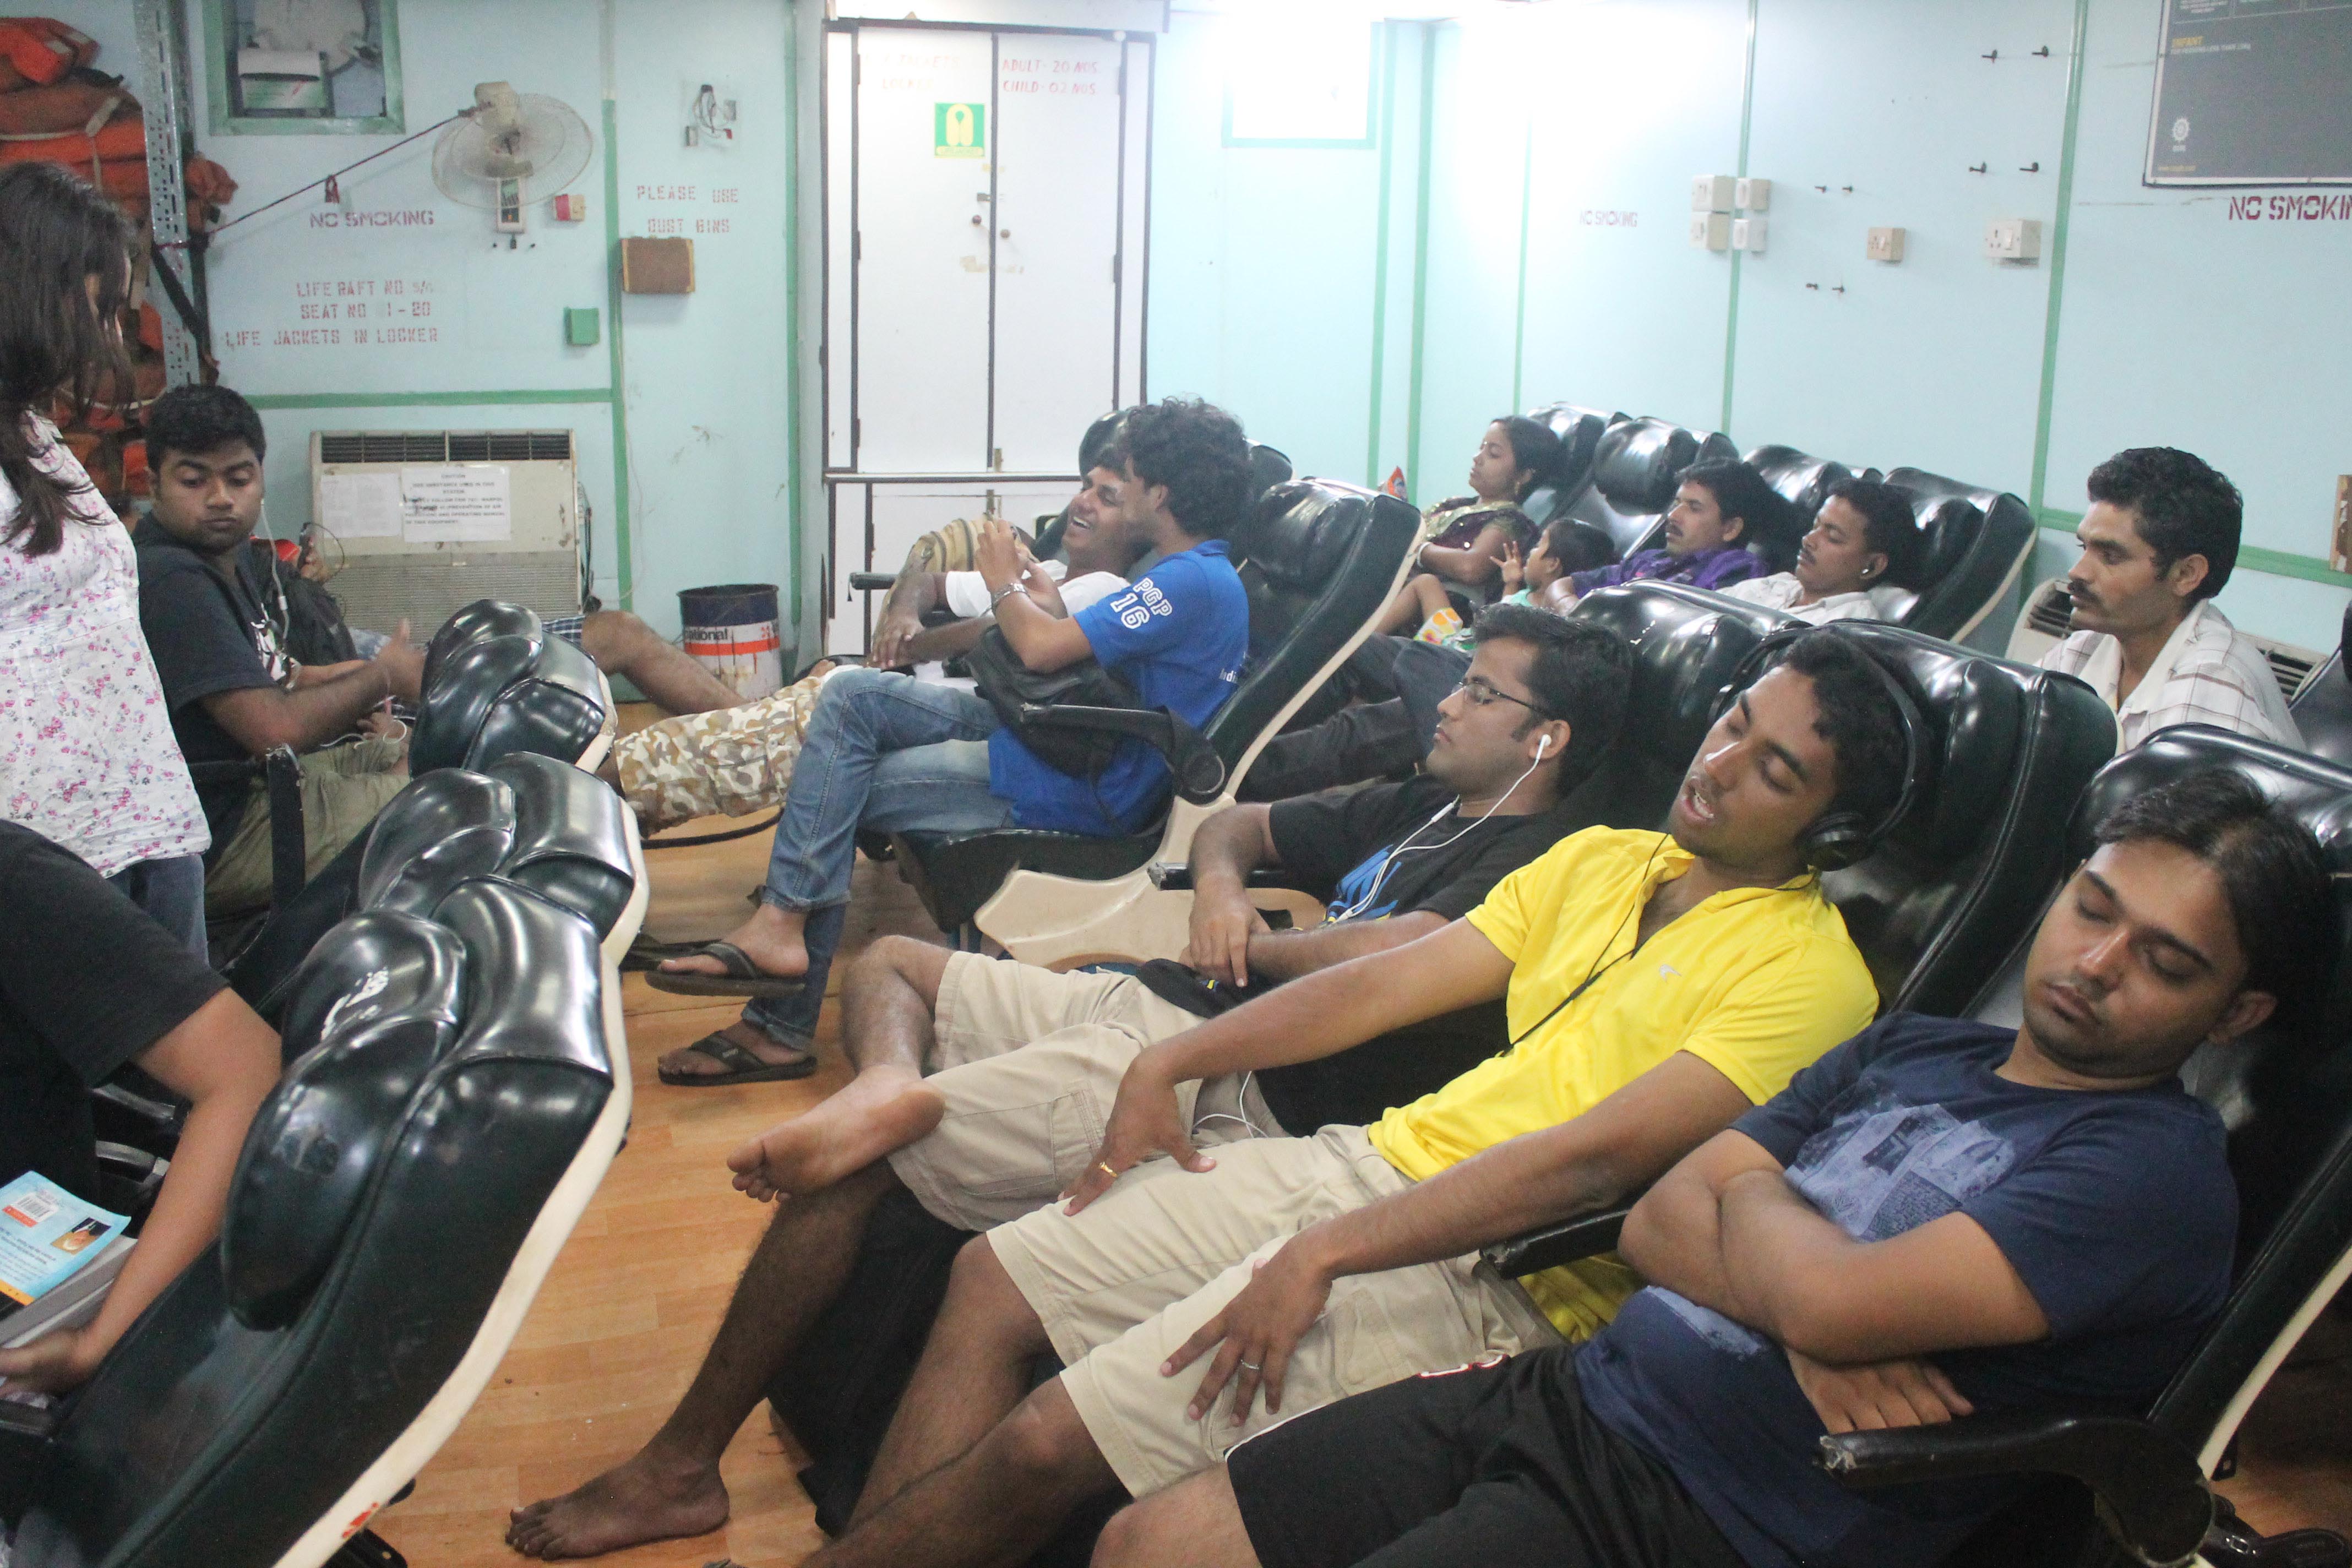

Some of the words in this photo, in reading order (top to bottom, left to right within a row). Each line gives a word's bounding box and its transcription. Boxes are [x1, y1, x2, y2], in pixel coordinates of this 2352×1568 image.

[1053, 60, 1070, 73] 20
[1074, 61, 1098, 74] NOS
[1049, 81, 1068, 93] 02
[1072, 83, 1096, 95] NOS
[637, 185, 696, 200] PLEASE
[712, 188, 739, 203] USE
[2229, 195, 2262, 221] NO
[309, 212, 339, 228] NO
[344, 210, 434, 227] SMOKING
[647, 218, 684, 233] DUST
[695, 218, 730, 233] BINS
[1580, 210, 1592, 225] NO
[1595, 210, 1638, 227] SMOKING
[296, 281, 332, 297] LIFE
[337, 280, 375, 296] RAFT
[384, 280, 404, 295] NO
[300, 304, 339, 319] SEAT
[347, 303, 367, 318] NO
[225, 330, 261, 347] LIFE
[274, 329, 340, 346] JACKETS
[355, 328, 368, 344] IN
[377, 327, 438, 344] LOCKER
[1133, 578, 1173, 616] PGP
[1110, 592, 1150, 629] 16
[1219, 668, 1238, 683] Indi
